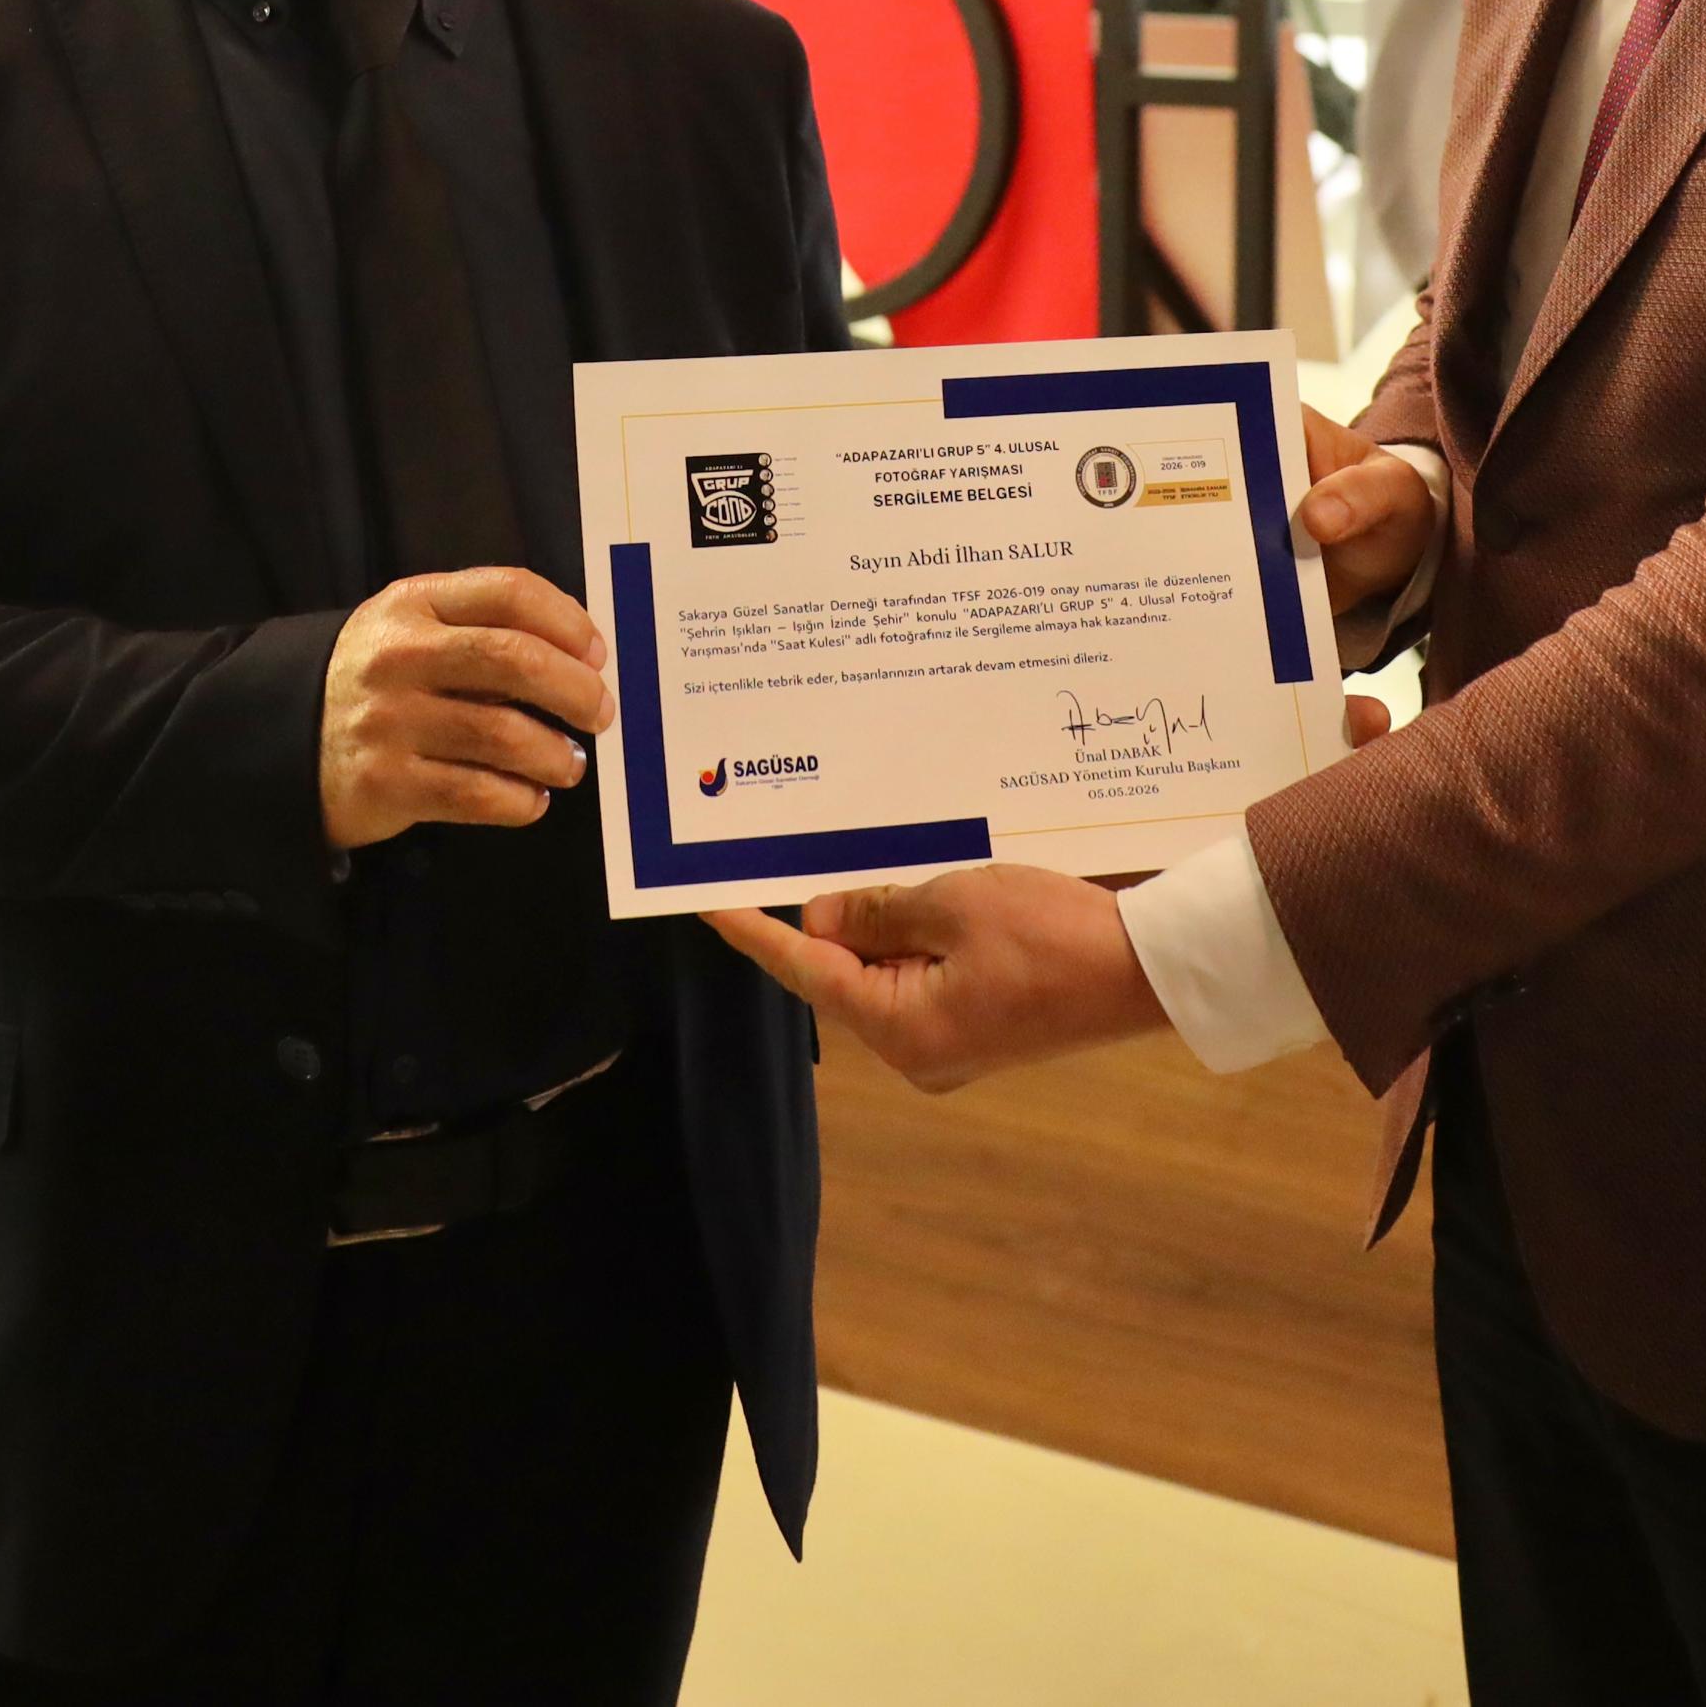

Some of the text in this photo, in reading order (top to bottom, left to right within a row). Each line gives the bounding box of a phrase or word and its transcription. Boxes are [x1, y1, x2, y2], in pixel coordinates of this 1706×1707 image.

[937, 445, 974, 458] GRUP
[993, 443, 1006, 455] 4.
[1008, 440, 1060, 454] ULUSAL
[874, 463, 1023, 484] FOTOĞRAF YARIŞMASI
[1160, 461, 1183, 471] 2026
[1190, 460, 1207, 469] 019
[703, 477, 750, 490] GRUP
[873, 481, 1033, 508] SERGİLEME BELGESİ
[849, 541, 1074, 574] Sayın Abdi İlhan SALUR
[678, 573, 1233, 622] Sakarya Güzel Sanatlar Derneği tarafından TFSF 2026-019 onay numarası ile düzenlenen
[679, 625, 726, 640] "Şehrin
[732, 622, 772, 639] Işıkları
[792, 619, 825, 634] Işığın
[830, 615, 867, 629] İzinde
[873, 610, 910, 626] Şehir"
[916, 609, 957, 623] konulu
[1059, 599, 1095, 613] GRUP
[1120, 597, 1133, 607] 4.
[1138, 592, 1175, 607] Ulusal
[1180, 587, 1234, 604] Fotoğraf
[770, 639, 806, 651] "Saat
[807, 632, 851, 649] Kulesi"
[855, 632, 877, 646] adlı
[879, 628, 952, 645] fotoğrafınız
[954, 626, 969, 638] ile
[971, 622, 1032, 639] Sergileme
[1034, 620, 1078, 634] almaya
[1079, 615, 1103, 629] hak
[1104, 612, 1172, 627] kazandınız.
[683, 651, 1113, 695] Sizi içtenlikle tebrik eder, başarılarınızın artarak devam etmesini dileriz.
[733, 753, 819, 779] SAGÜSAD
[1074, 744, 1162, 764] Ünal DABAK
[999, 757, 1241, 789] SAGÜSAD Yönetim Kurulu Başkanı
[1087, 784, 1160, 799] 05.05.2026
